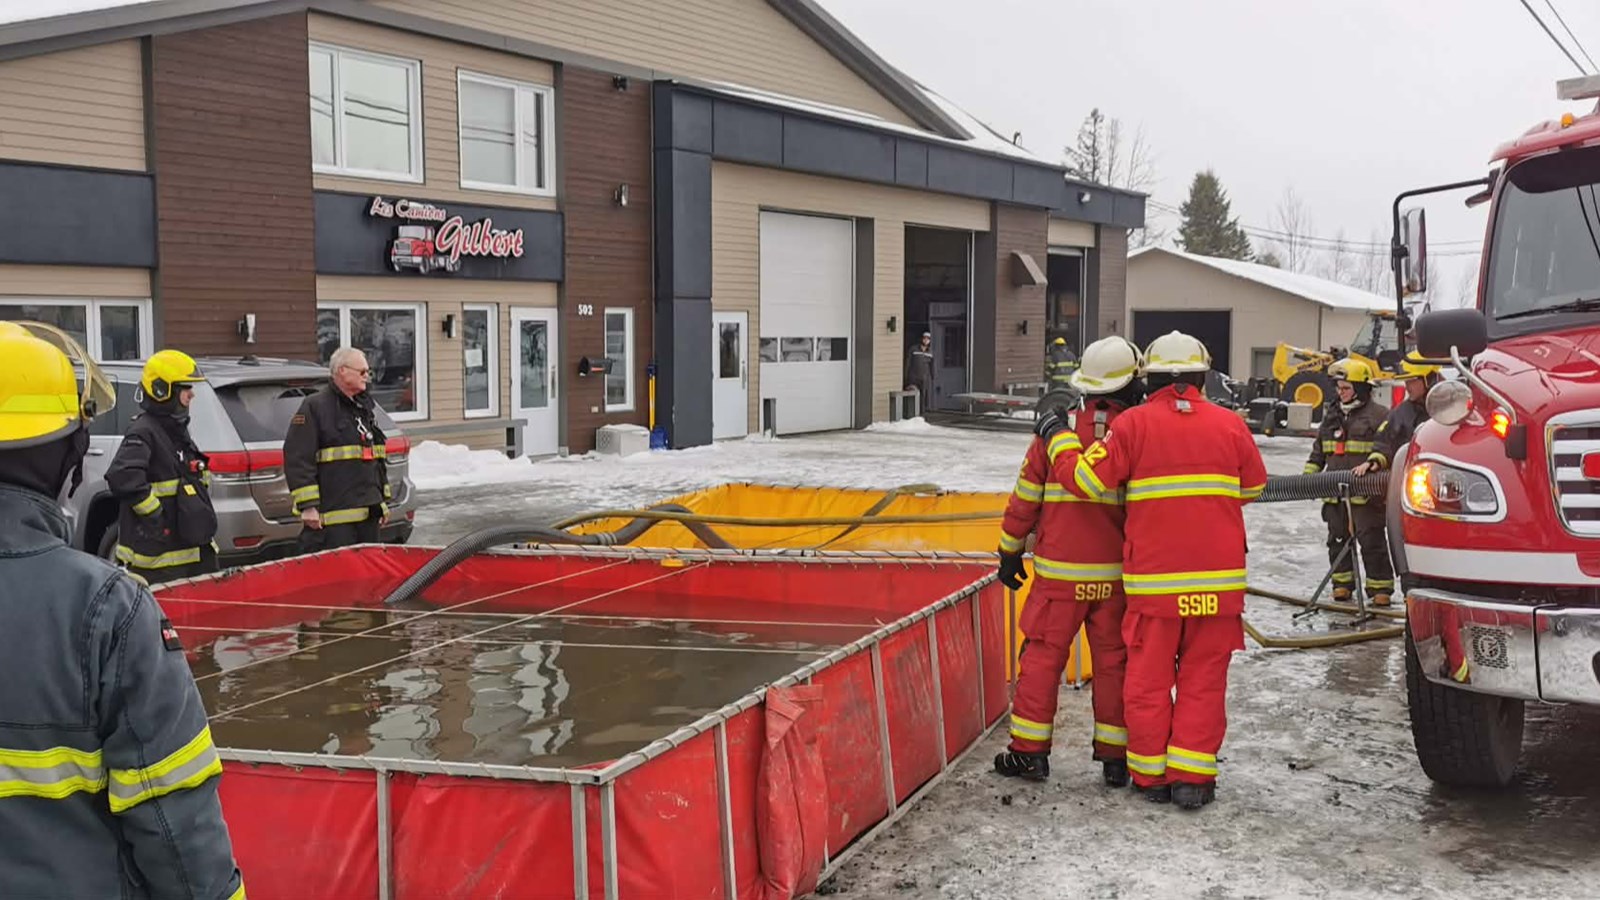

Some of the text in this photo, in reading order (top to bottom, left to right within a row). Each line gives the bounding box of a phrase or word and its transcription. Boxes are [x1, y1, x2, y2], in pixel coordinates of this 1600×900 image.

[370, 196, 446, 221] Les Camions
[435, 215, 524, 264] Gilbert
[578, 304, 593, 316] 502
[1075, 583, 1113, 601] SSIB
[1178, 594, 1219, 616] SSIB
